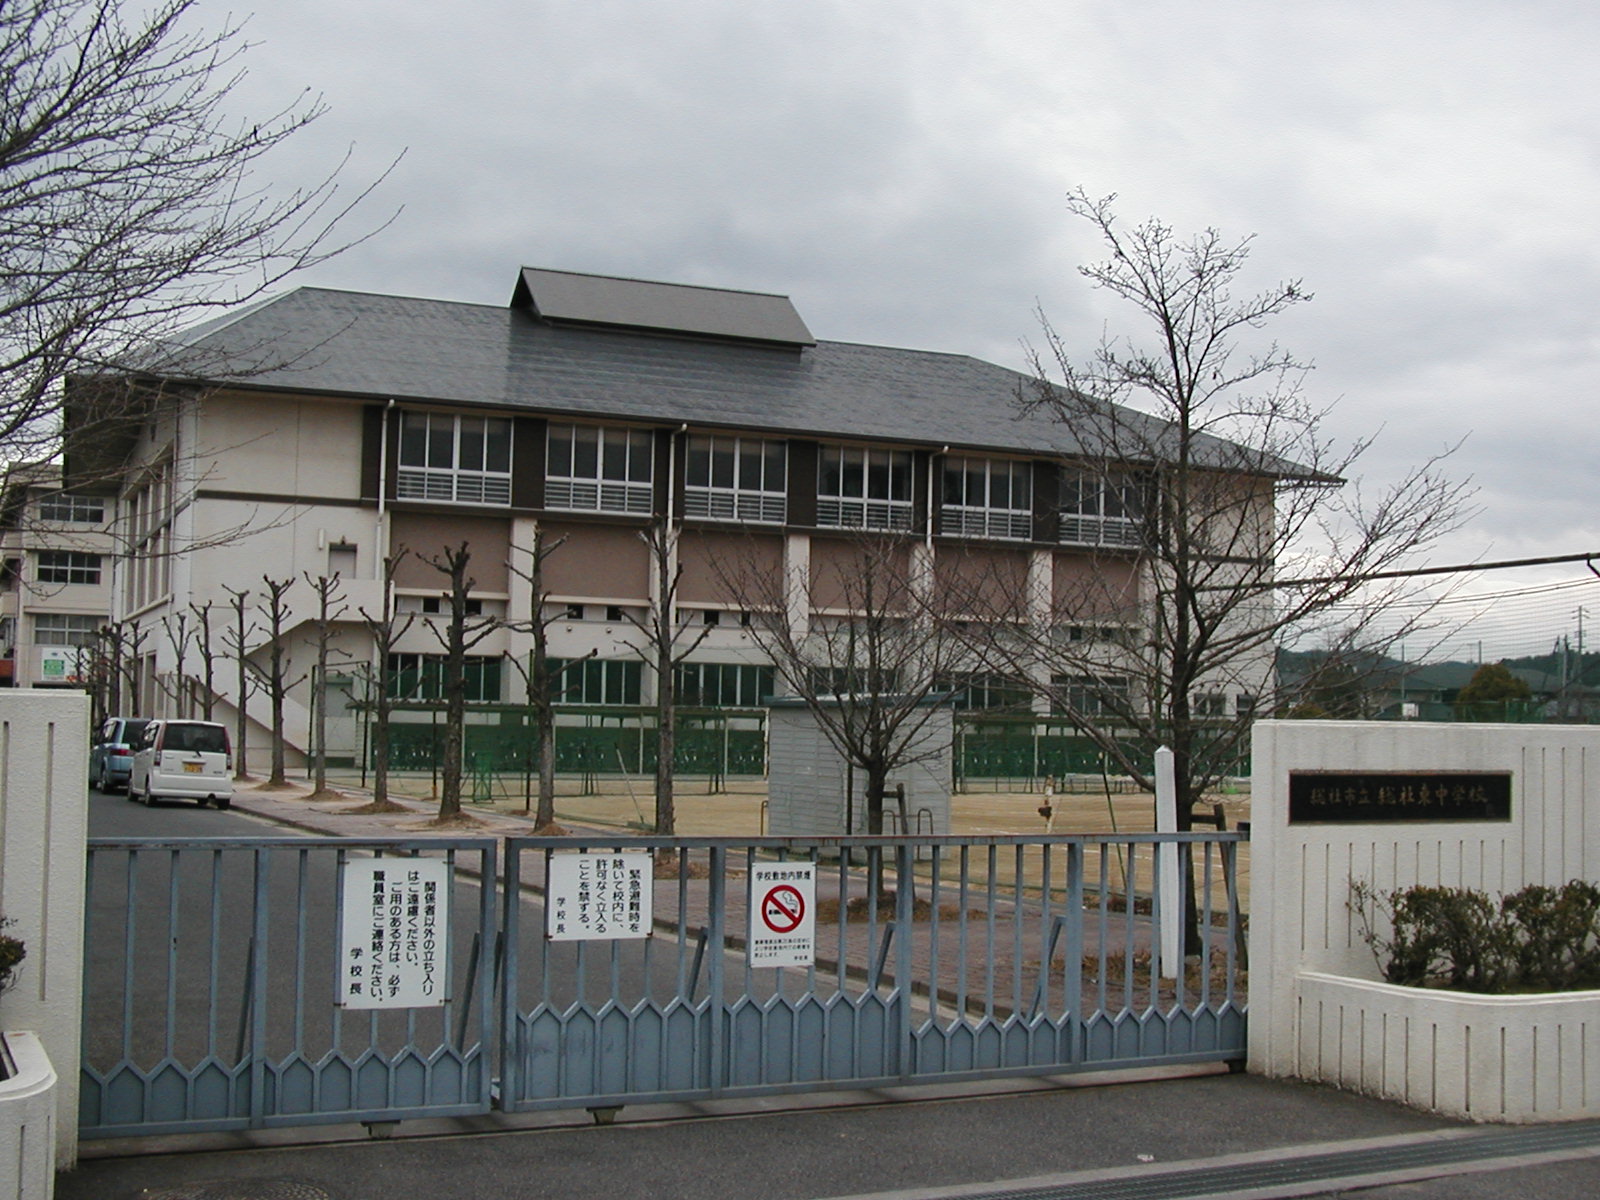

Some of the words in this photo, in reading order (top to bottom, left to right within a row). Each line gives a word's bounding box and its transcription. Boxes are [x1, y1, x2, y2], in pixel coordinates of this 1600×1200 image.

[578, 859, 591, 930] ことを禁ずる。
[595, 858, 608, 934] 許可なく立入る
[612, 858, 625, 929] 除いて校内に、
[628, 868, 641, 933] 緊急避難時を
[756, 870, 811, 881] 学校敷地内禁煙
[370, 870, 385, 1003] 職員室にご連絡ください。
[388, 881, 402, 998] ご用のある方は、必ず
[406, 870, 420, 968] はご遠慮ください。
[422, 881, 436, 997] 関係者以外の立ち入り
[556, 897, 566, 934] 学校長
[349, 947, 363, 995] 学校長
